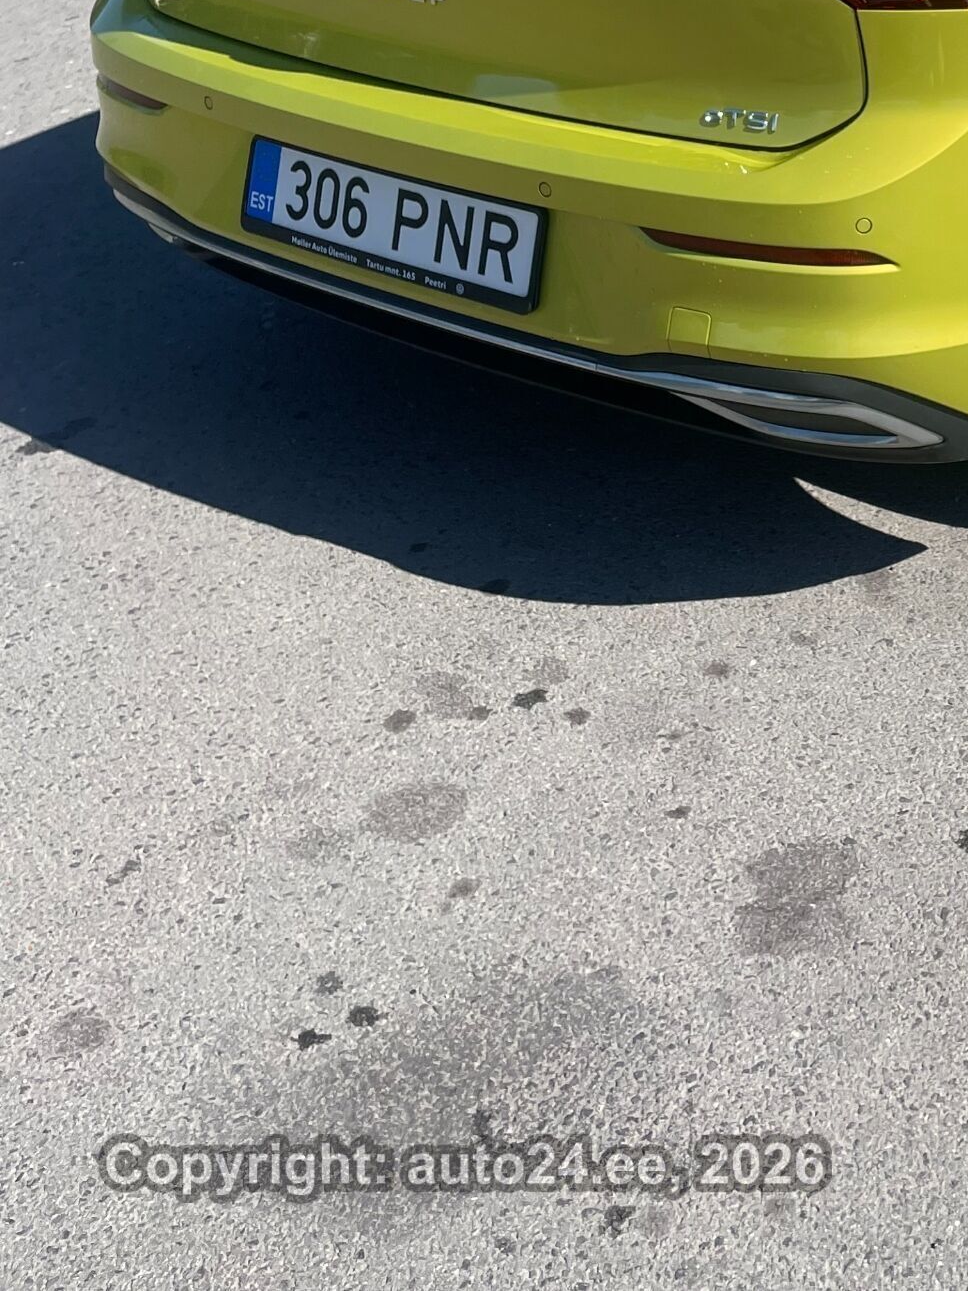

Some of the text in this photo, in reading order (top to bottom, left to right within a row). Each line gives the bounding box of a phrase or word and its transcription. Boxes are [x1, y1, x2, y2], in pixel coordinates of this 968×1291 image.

[250, 191, 274, 212] EST
[285, 160, 519, 284] 306 PNR
[311, 242, 328, 254] Auto
[328, 245, 358, 264] Ülemiste
[366, 258, 384, 272] Tartu
[384, 265, 401, 277] mnt.
[402, 270, 416, 281] 165
[424, 276, 447, 290] Peetri
